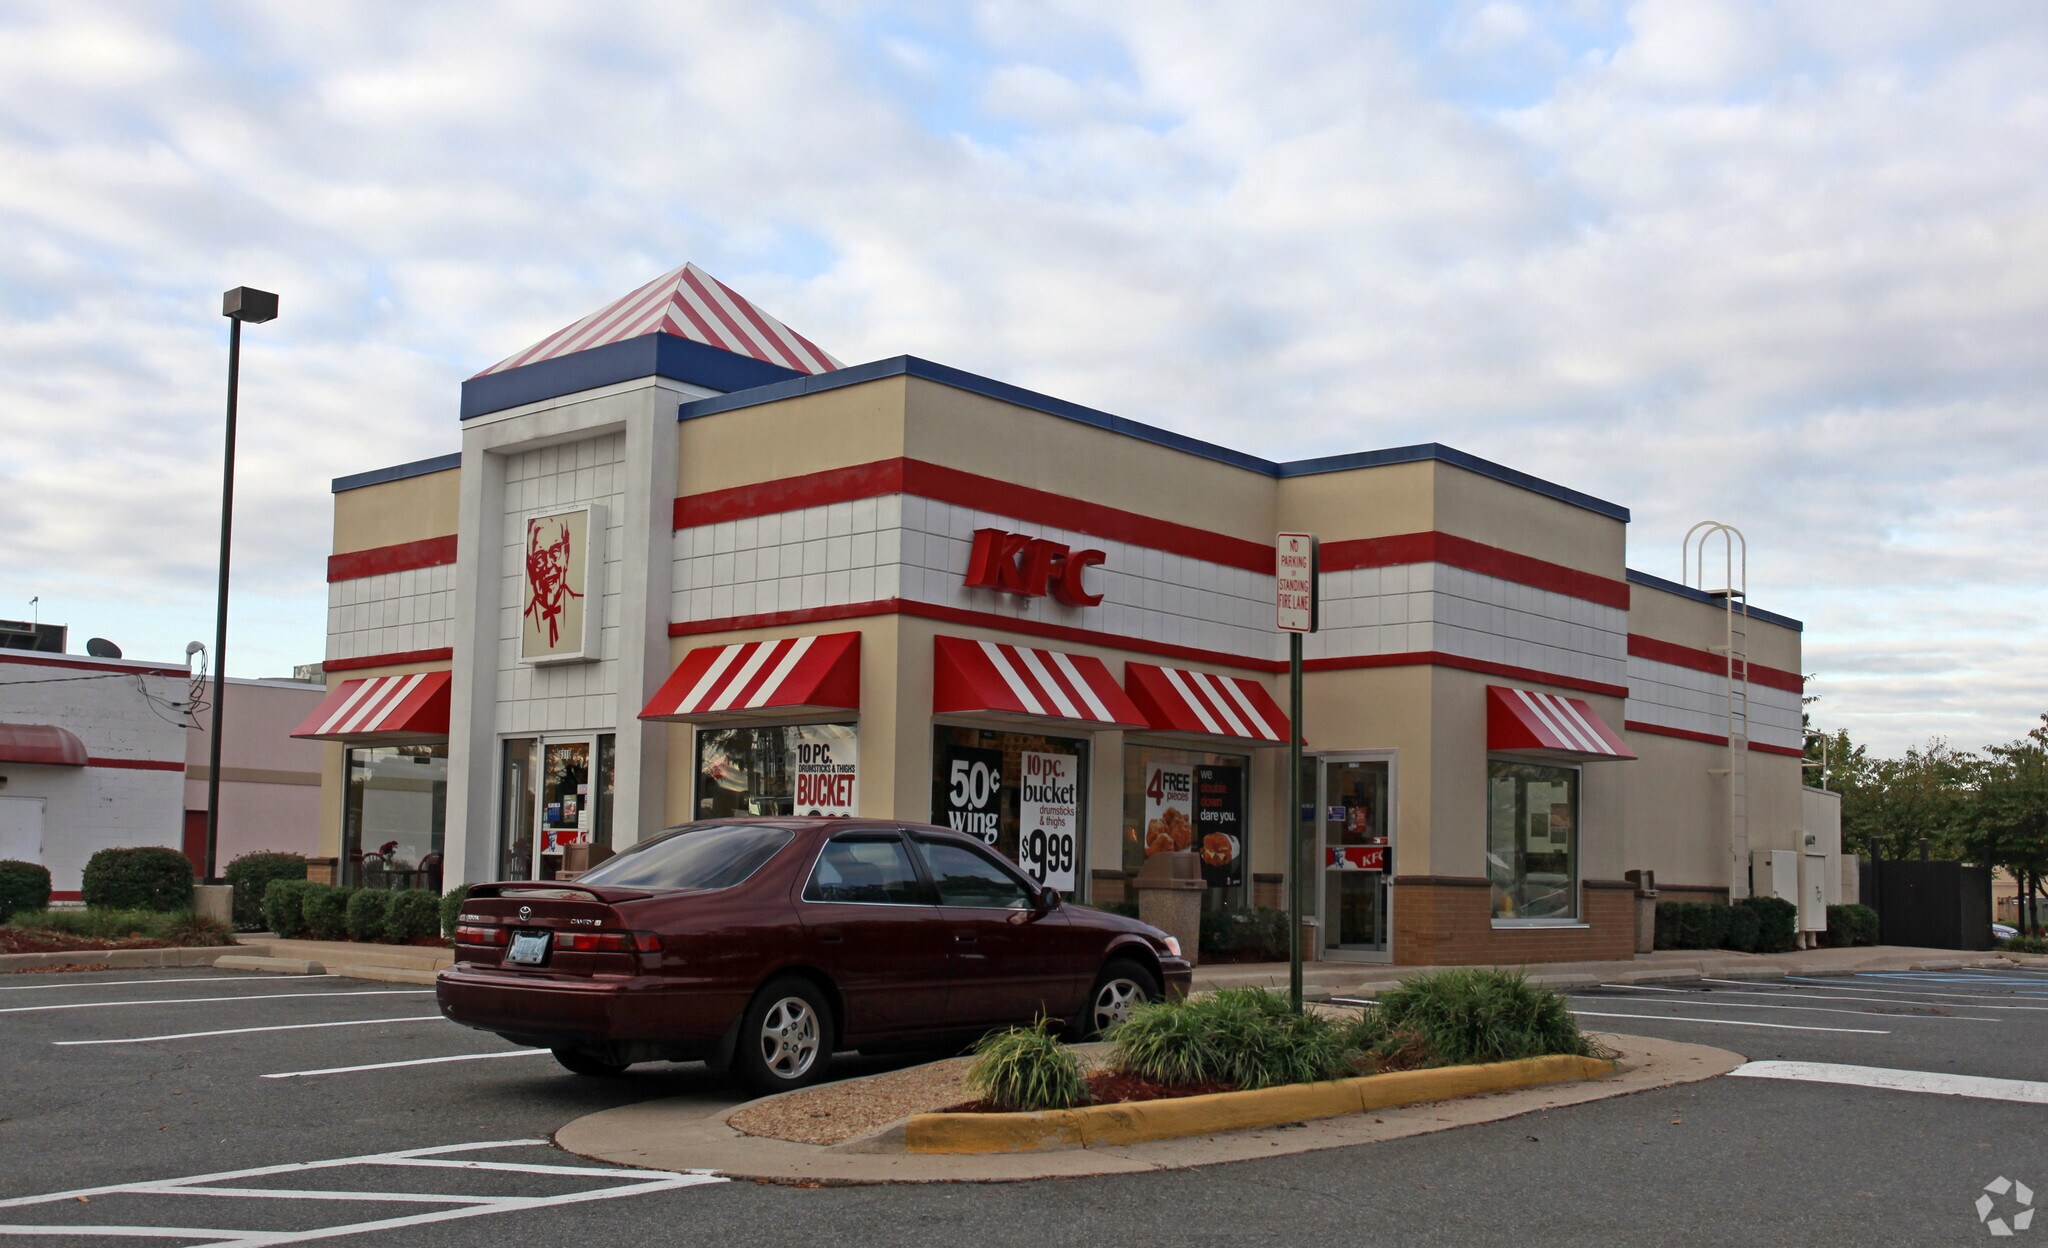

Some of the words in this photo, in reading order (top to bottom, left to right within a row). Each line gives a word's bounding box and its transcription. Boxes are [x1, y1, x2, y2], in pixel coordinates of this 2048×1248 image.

[1289, 540, 1299, 552] NO
[962, 528, 1106, 607] KFC
[1281, 555, 1307, 568] PARKING
[1279, 578, 1309, 593] STANDING
[1278, 593, 1292, 609] FIRE
[1293, 594, 1309, 611] LANE
[797, 743, 811, 764] 10
[813, 743, 833, 764] PC.
[798, 764, 831, 773] DRUMSTICKS
[837, 764, 856, 774] THIGHS
[1027, 755, 1042, 776] 10
[1043, 759, 1066, 785] pc.
[1200, 769, 1213, 780] we
[797, 773, 856, 806] BUCKET
[949, 759, 1000, 809] 50¢
[1023, 776, 1075, 804] bucket
[1147, 768, 1164, 806] 4
[1163, 772, 1190, 792] FREE
[1166, 792, 1189, 802] pieces
[1040, 805, 1075, 816] drumsticks
[1200, 808, 1219, 821] dare
[1219, 811, 1237, 824] you.
[948, 803, 999, 845] wing
[1039, 816, 1045, 826] &
[1046, 816, 1066, 829] thighs
